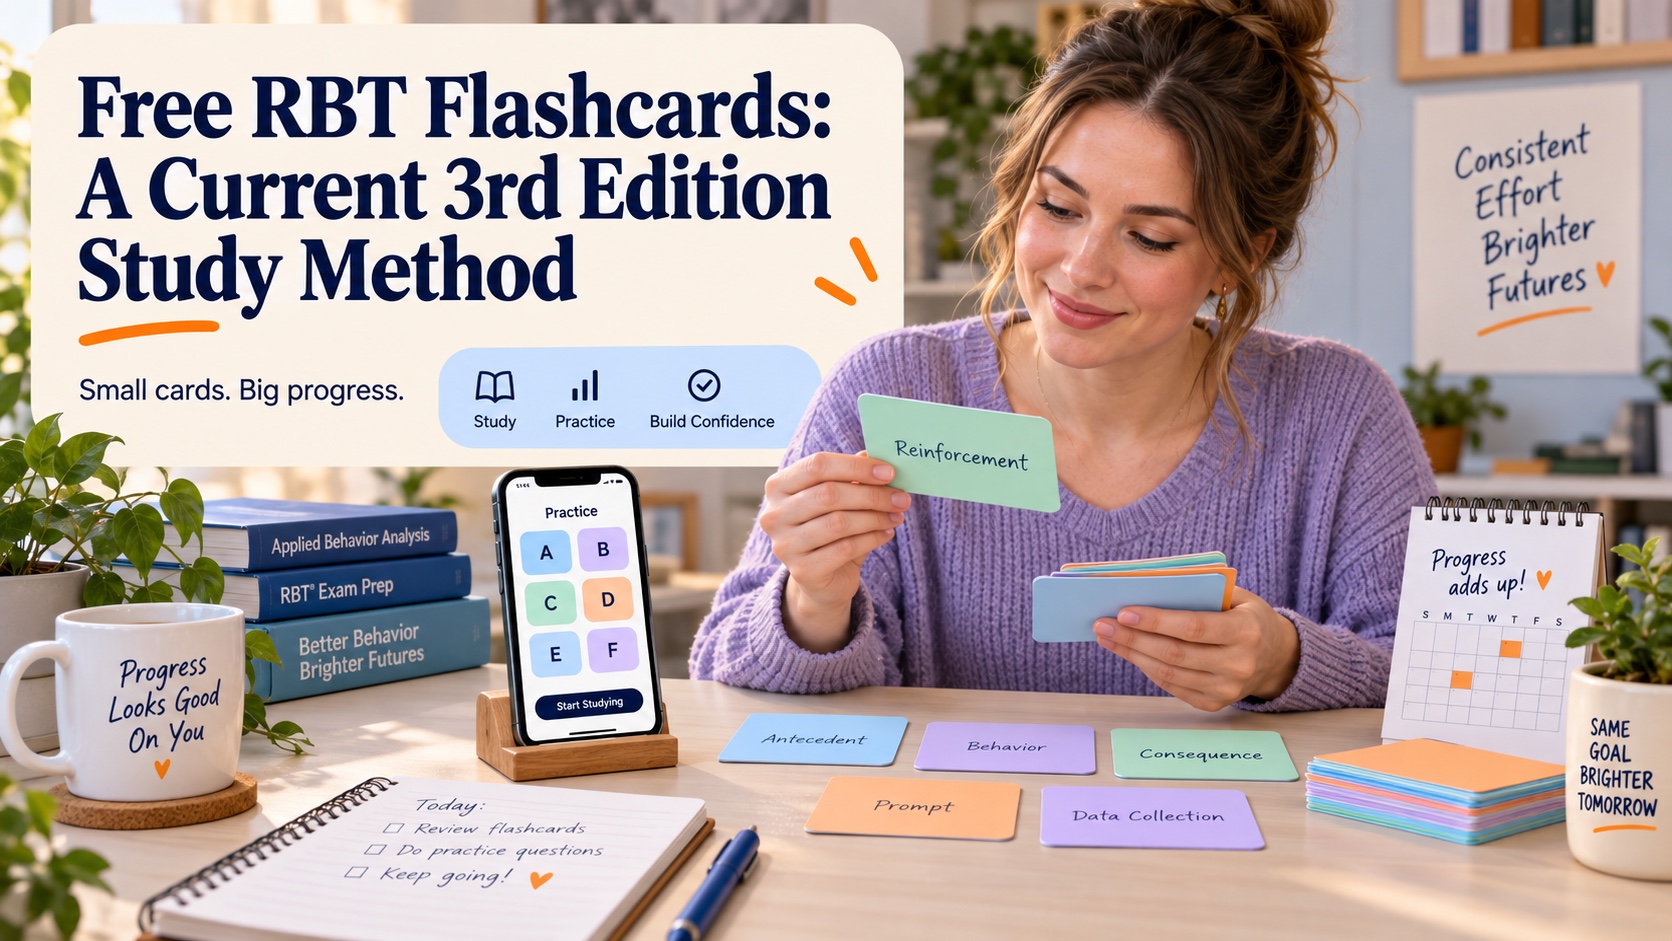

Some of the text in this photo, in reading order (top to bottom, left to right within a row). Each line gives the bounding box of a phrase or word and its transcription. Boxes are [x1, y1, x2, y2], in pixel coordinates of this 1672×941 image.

[1455, 123, 1590, 179] Consistent
[1476, 170, 1562, 220] Effort
[1482, 213, 1595, 266] Brighter
[1488, 268, 1586, 311] Futures
[894, 439, 1029, 473] Reinforcement
[546, 505, 597, 518] Practice
[272, 534, 320, 557] Applied
[325, 531, 378, 549] Behavior
[382, 527, 430, 546] Analysis
[540, 542, 609, 560] A B
[1432, 548, 1506, 576] Progress
[319, 583, 357, 599] Exam
[362, 578, 393, 596] Prep
[1449, 569, 1525, 599] adds up!
[545, 592, 614, 610] C D
[1444, 612, 1452, 620] M
[1467, 613, 1473, 621] T
[1556, 618, 1562, 626] S
[299, 623, 419, 656] Better Behavior
[551, 642, 617, 662] E F
[120, 657, 206, 691] Progress
[300, 648, 424, 682] Brighter Futures
[109, 678, 221, 723] Looks Good
[556, 697, 624, 711] Start Studying
[128, 720, 204, 753] On You
[1591, 718, 1630, 738] SAME
[761, 733, 869, 745] Antecedent
[968, 741, 1046, 751] Behavior
[1140, 749, 1262, 763] Consequence
[1590, 742, 1631, 763] GOAL
[1581, 765, 1654, 791] BRIGHTER
[417, 798, 485, 817] Today:
[874, 800, 954, 815] Prompt
[1578, 792, 1657, 817] TOMORROW
[1073, 810, 1224, 821] Data Collection
[414, 821, 586, 836] Review flashcards
[397, 845, 604, 861] Do practice questions
[380, 867, 513, 888] Keep going!
